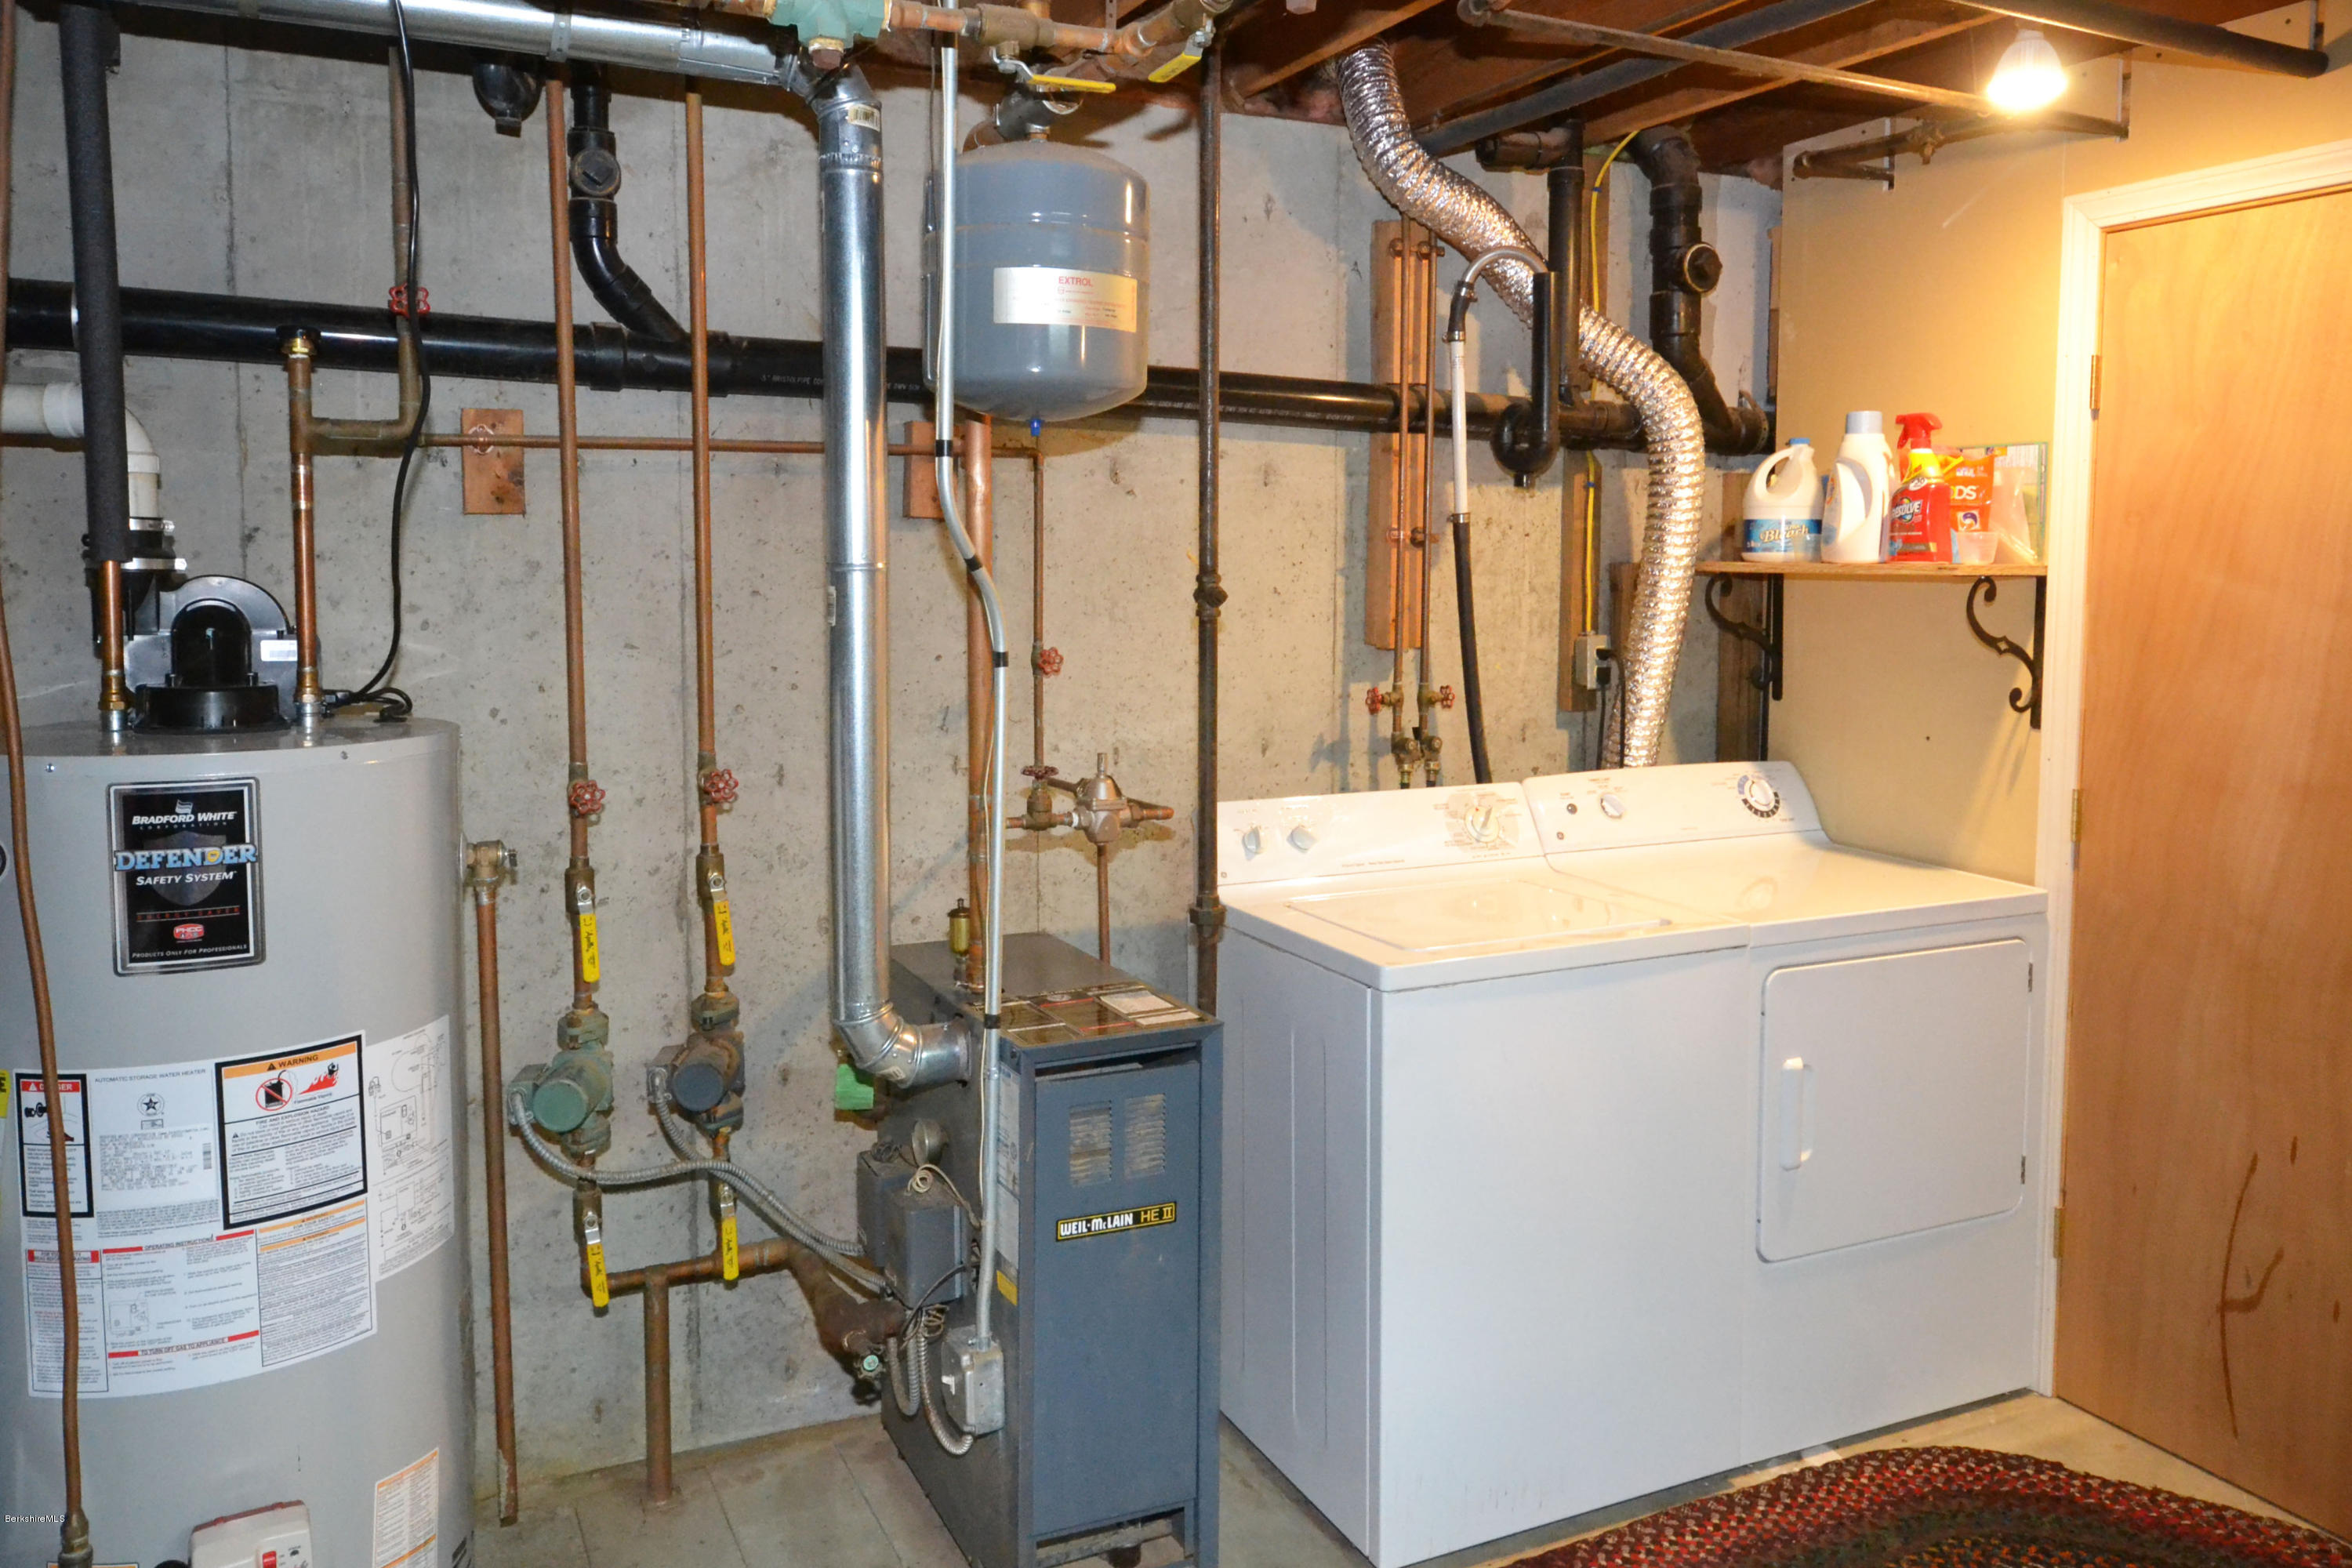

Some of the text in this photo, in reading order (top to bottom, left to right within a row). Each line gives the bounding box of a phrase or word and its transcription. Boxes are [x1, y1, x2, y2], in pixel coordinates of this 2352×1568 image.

[1058, 276, 1093, 286] EXTROL
[1759, 524, 1809, 543] Bleach
[132, 811, 236, 825] BRADFORD WHITE
[115, 844, 257, 870] DEFENDER
[136, 872, 234, 886] SAFETY SYSTEM
[198, 944, 248, 953] PROFESSIONALS
[278, 1054, 318, 1068] WARNING
[95, 1075, 128, 1083] AUTOMATIC
[1140, 1208, 1160, 1222] HE
[1162, 1207, 1173, 1219] II
[144, 1242, 174, 1250] OPERATING
[163, 1345, 174, 1354] OFF
[196, 1339, 226, 1348] APPLIANCE
